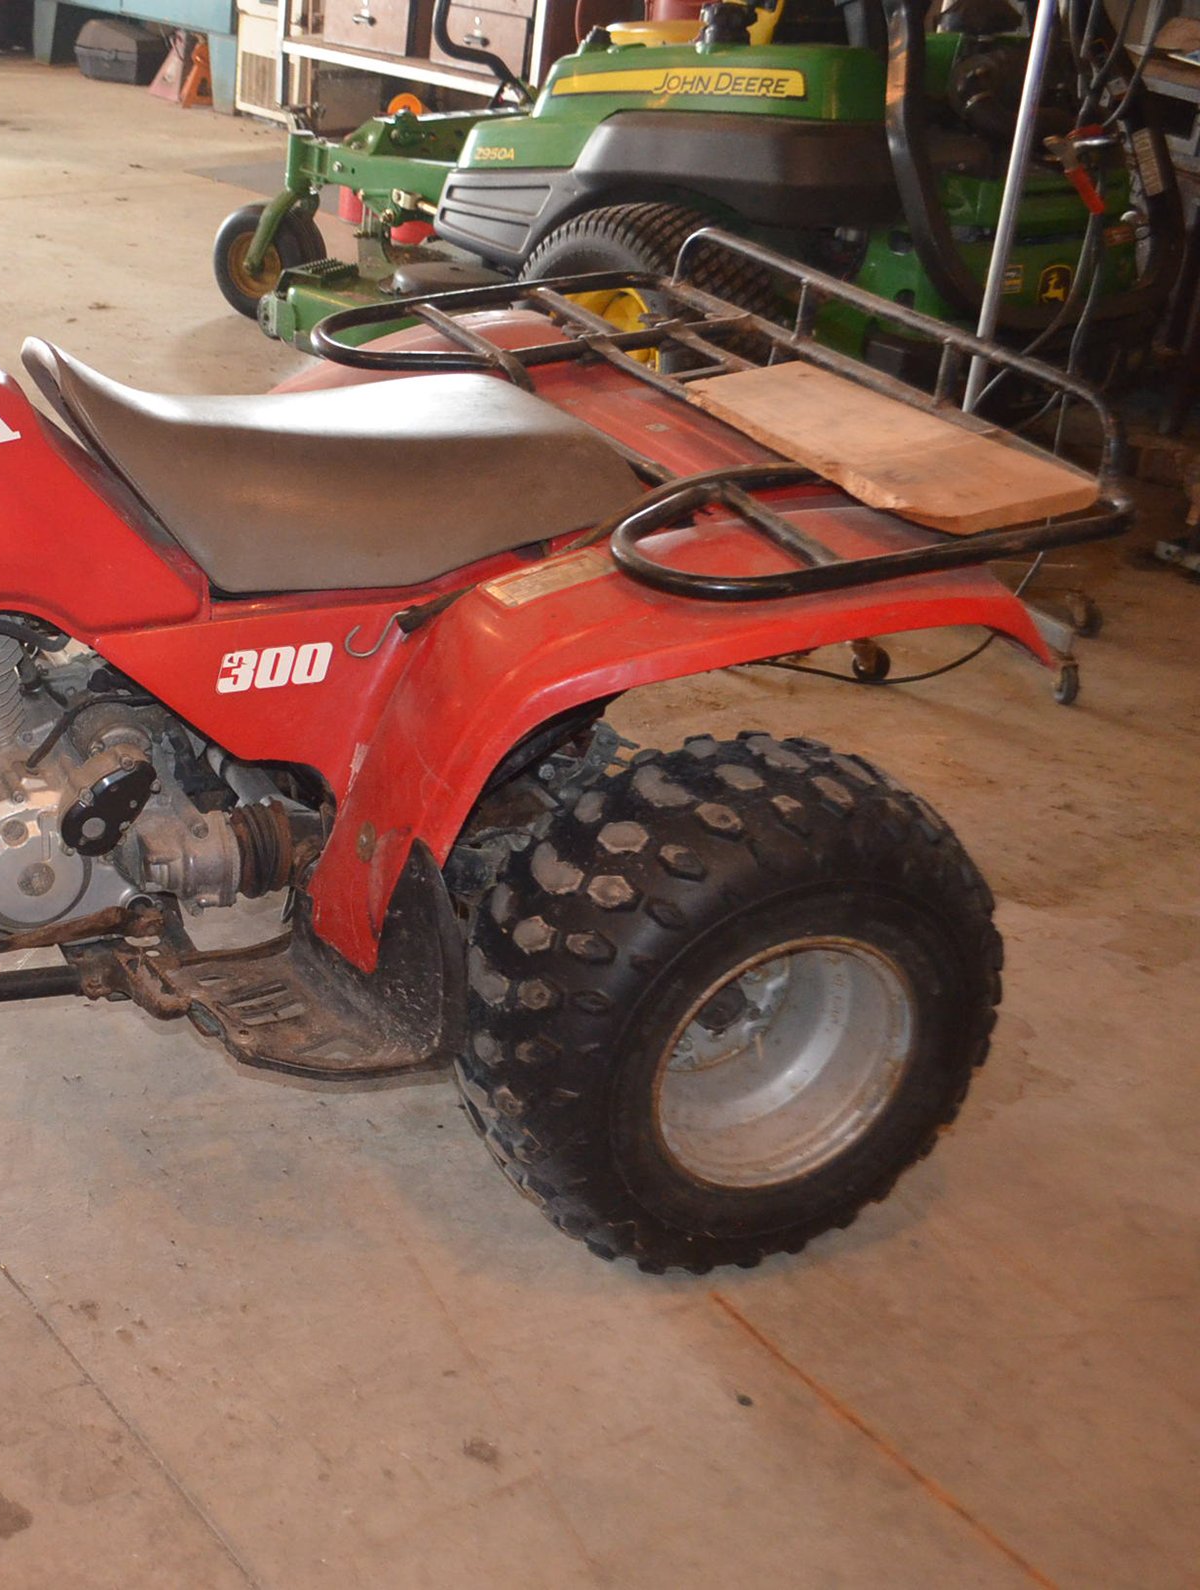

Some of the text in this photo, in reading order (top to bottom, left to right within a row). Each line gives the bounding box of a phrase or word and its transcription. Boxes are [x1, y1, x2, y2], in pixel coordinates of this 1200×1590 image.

[654, 72, 790, 94] JOHN DEERE
[216, 641, 334, 694] 300
